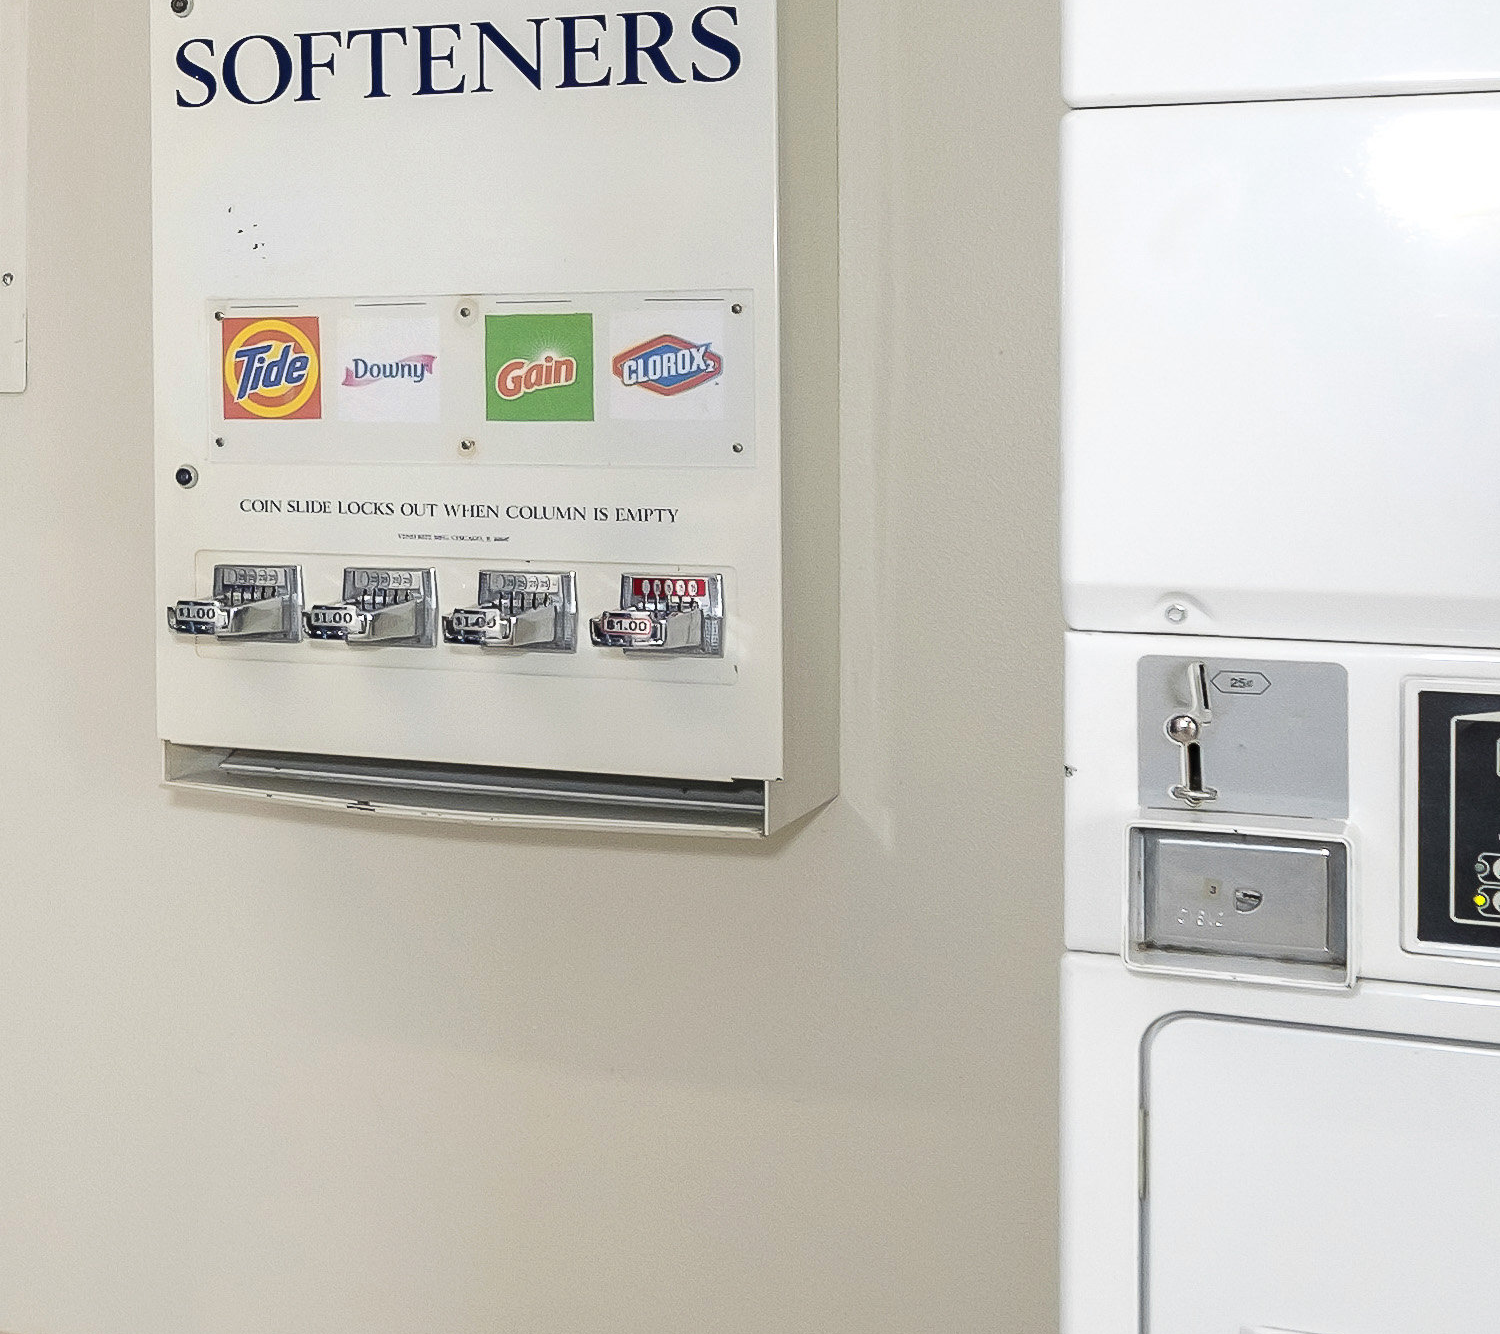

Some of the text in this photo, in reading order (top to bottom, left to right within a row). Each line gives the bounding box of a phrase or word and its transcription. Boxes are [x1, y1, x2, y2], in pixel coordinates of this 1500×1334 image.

[175, 5, 742, 108] SOFTENERS
[235, 344, 309, 400] Tide
[352, 358, 428, 383] Downy
[497, 355, 574, 397] Gain
[239, 499, 678, 523] COIN SLIDE LOCKS OUT WHEN COLUMN IS EMPTY
[178, 608, 215, 619] $1.00
[313, 612, 353, 624] $1.00
[606, 620, 647, 632] $1.00
